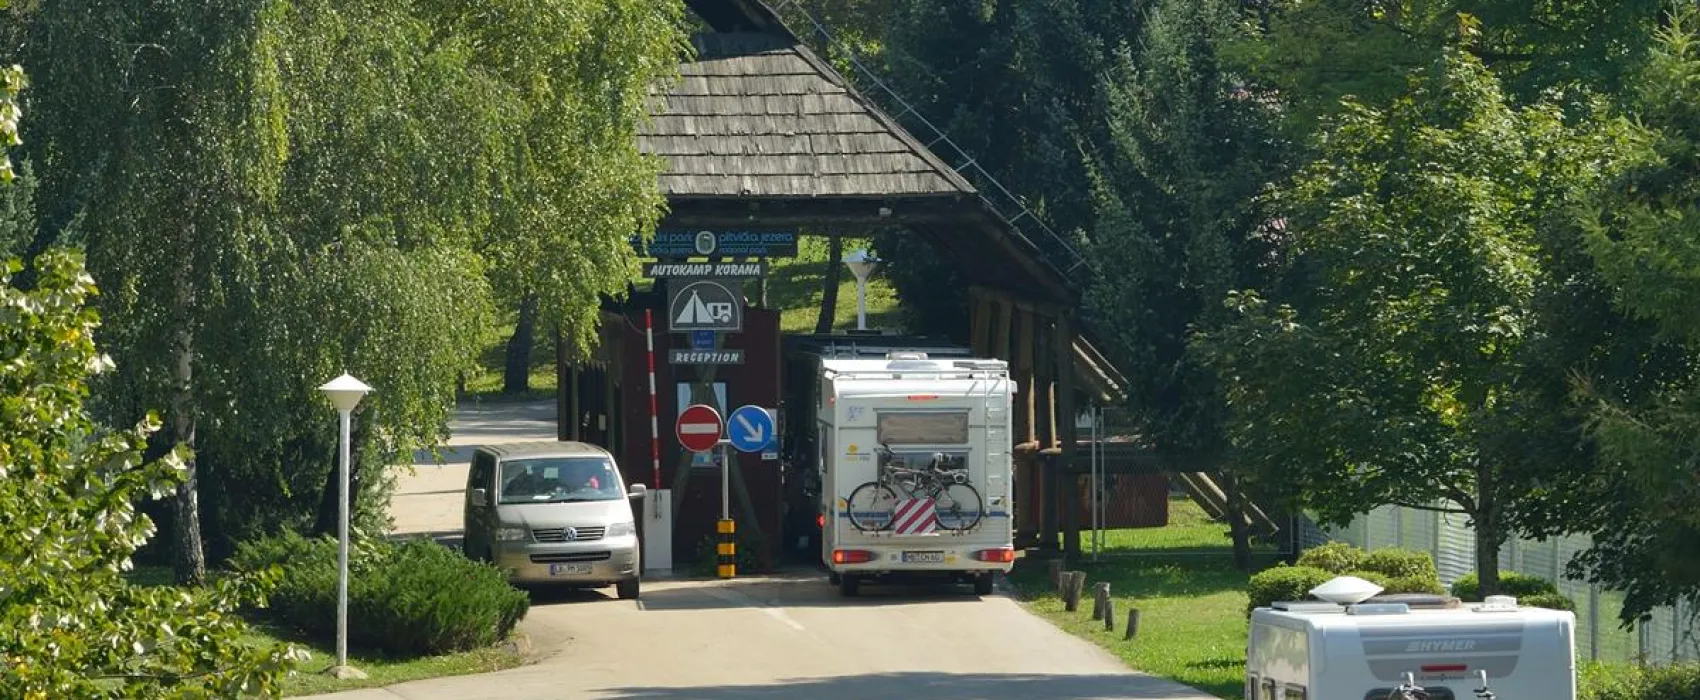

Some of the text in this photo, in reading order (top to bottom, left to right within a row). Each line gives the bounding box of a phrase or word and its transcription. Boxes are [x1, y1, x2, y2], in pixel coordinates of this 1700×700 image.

[650, 264, 761, 276] AUTOKAMP KORANA
[676, 352, 739, 362] RECEPTION
[1420, 640, 1476, 651] HYMER
